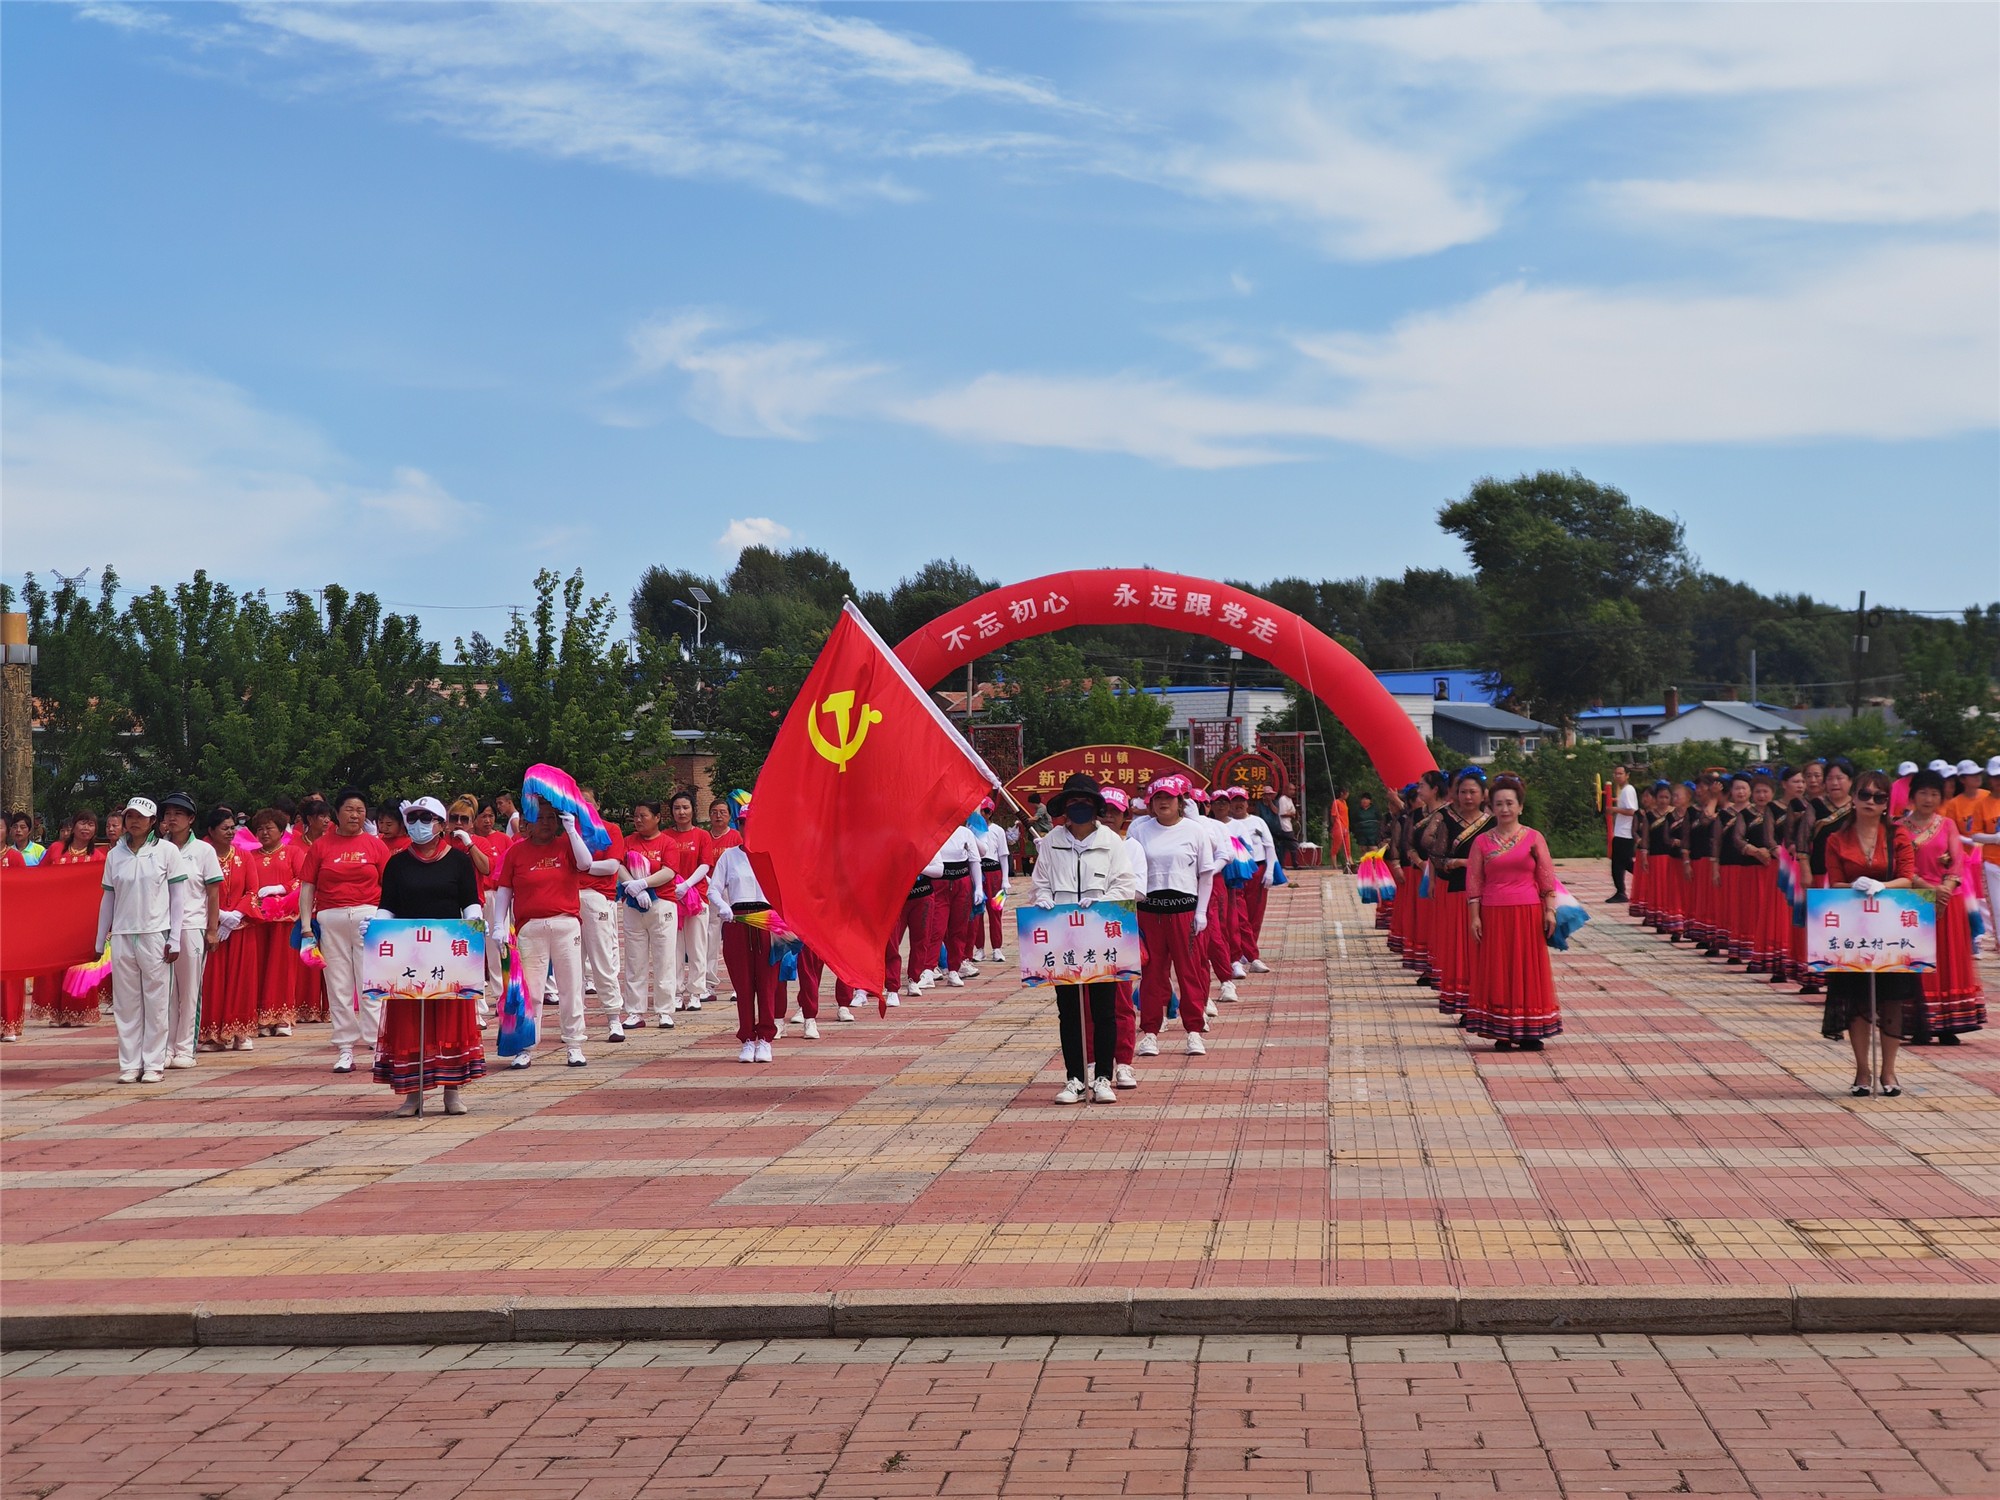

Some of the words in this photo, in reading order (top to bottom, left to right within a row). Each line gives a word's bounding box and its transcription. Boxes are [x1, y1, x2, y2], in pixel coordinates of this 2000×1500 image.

[942, 592, 1069, 652] 不忘初心
[1113, 584, 1279, 645] 永远跟党走
[1084, 751, 1129, 764] 白山镇
[1234, 766, 1267, 781] 文明
[1824, 894, 1919, 928] 白山镇
[379, 926, 469, 958] 白山镇
[1033, 911, 1123, 945] 白山镇
[402, 965, 446, 981] 七村
